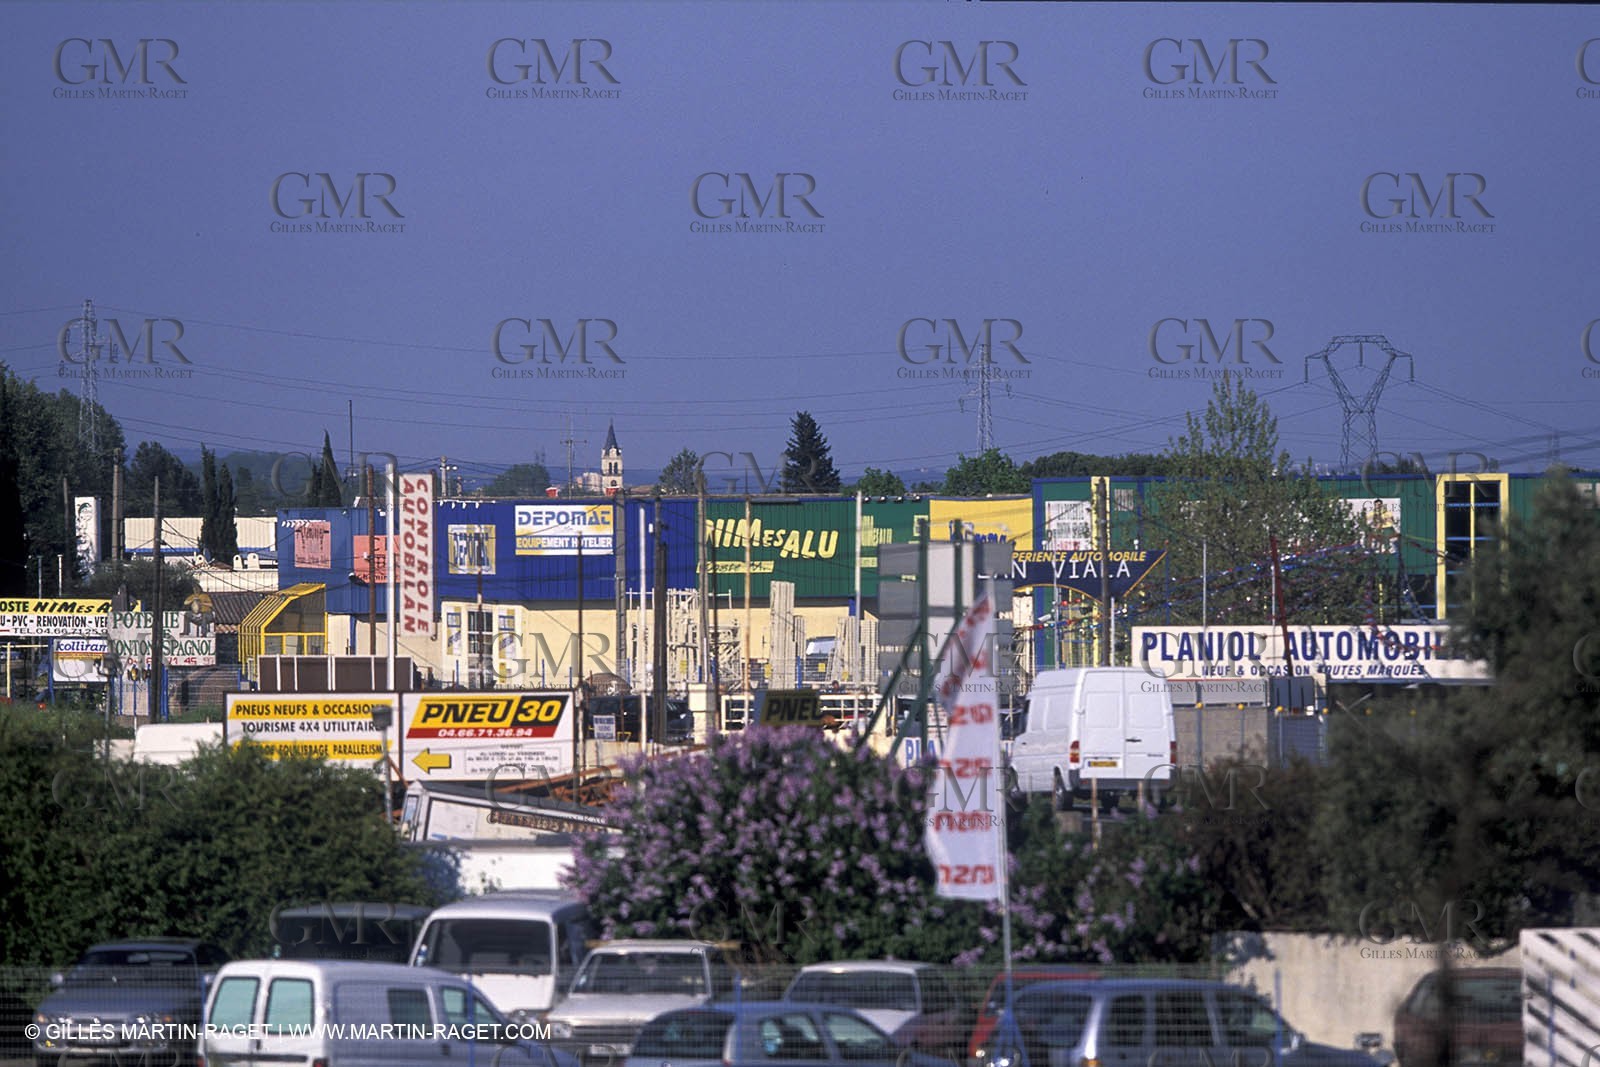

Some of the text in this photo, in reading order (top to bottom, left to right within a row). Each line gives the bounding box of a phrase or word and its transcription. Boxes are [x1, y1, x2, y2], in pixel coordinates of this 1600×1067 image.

[518, 510, 611, 526] DEPOMAT
[516, 537, 613, 549] EQUIPEMENT HTELIER
[403, 478, 416, 633] AUTOBILAN
[416, 478, 429, 633] CONTROLE
[36, 616, 87, 628] RENOVATION
[112, 611, 180, 629] POTEIE
[1141, 631, 1466, 661] PLANIOL AUTOMOBIL
[1251, 665, 1310, 676] OCCASON
[236, 704, 271, 716] PNEUS
[274, 703, 308, 715] NEUFS
[421, 699, 562, 724] PNEU 30
[241, 721, 296, 733] TOURISME
[333, 743, 388, 756] PARALLELISM
